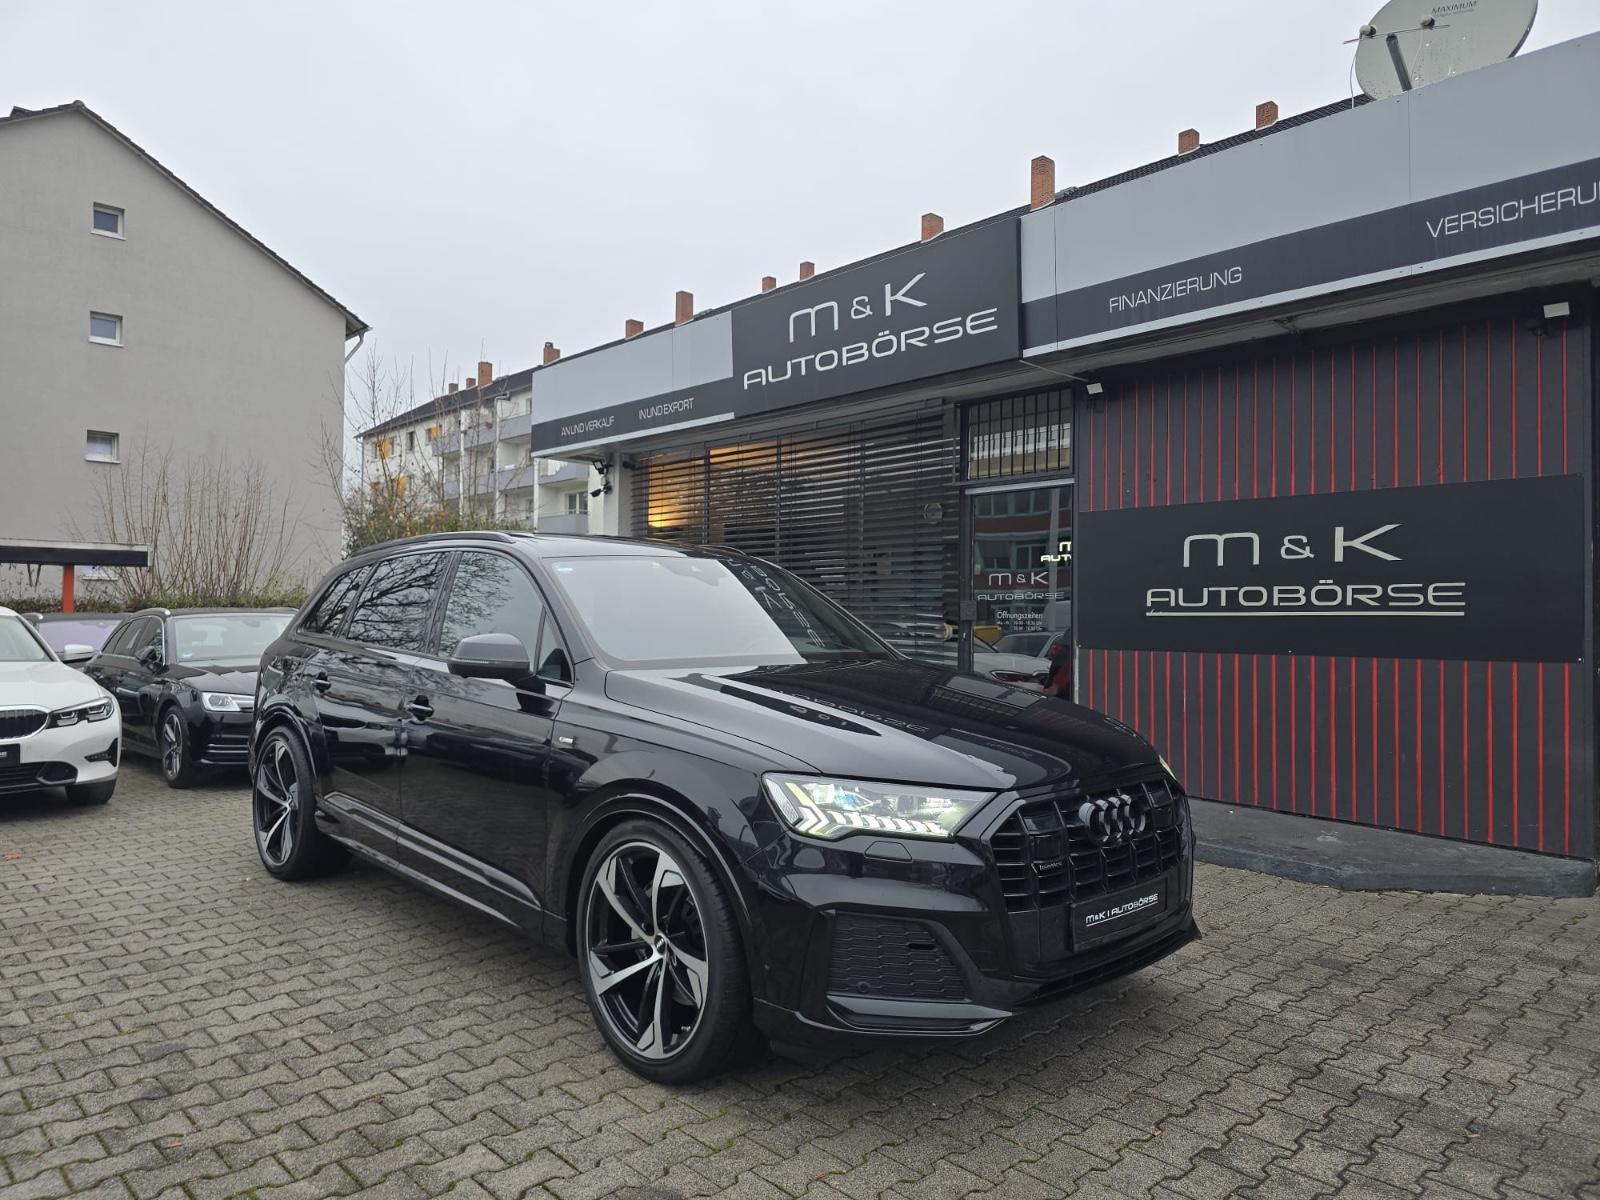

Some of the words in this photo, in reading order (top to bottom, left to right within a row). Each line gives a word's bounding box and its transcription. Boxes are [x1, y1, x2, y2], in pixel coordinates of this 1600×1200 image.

[1431, 0, 1477, 14] MAXIMUM
[1426, 180, 1600, 238] VERSICHERU
[1109, 266, 1243, 313] FINANZIERUNG
[789, 301, 839, 343] M
[850, 296, 873, 319] &
[884, 272, 928, 316] K
[743, 308, 998, 390] AUTOBÖRSE
[638, 409, 647, 420] IN
[647, 406, 662, 418] UND
[663, 397, 694, 415] EXPORT
[561, 426, 571, 437] AN
[571, 422, 584, 435] UND
[584, 416, 615, 431] VERKAUF
[1183, 532, 1260, 567] M
[1280, 535, 1314, 559] &
[1334, 523, 1403, 562] K
[988, 572, 1012, 586] M
[1016, 574, 1026, 583] &
[1030, 571, 1049, 585] K
[977, 591, 1065, 601] AUTOBÖRSE
[1146, 579, 1466, 607] AUTOBÖRSE
[996, 609, 1043, 621] Öffnungszeiten
[1111, 893, 1159, 916] AUTOBÖRSE
